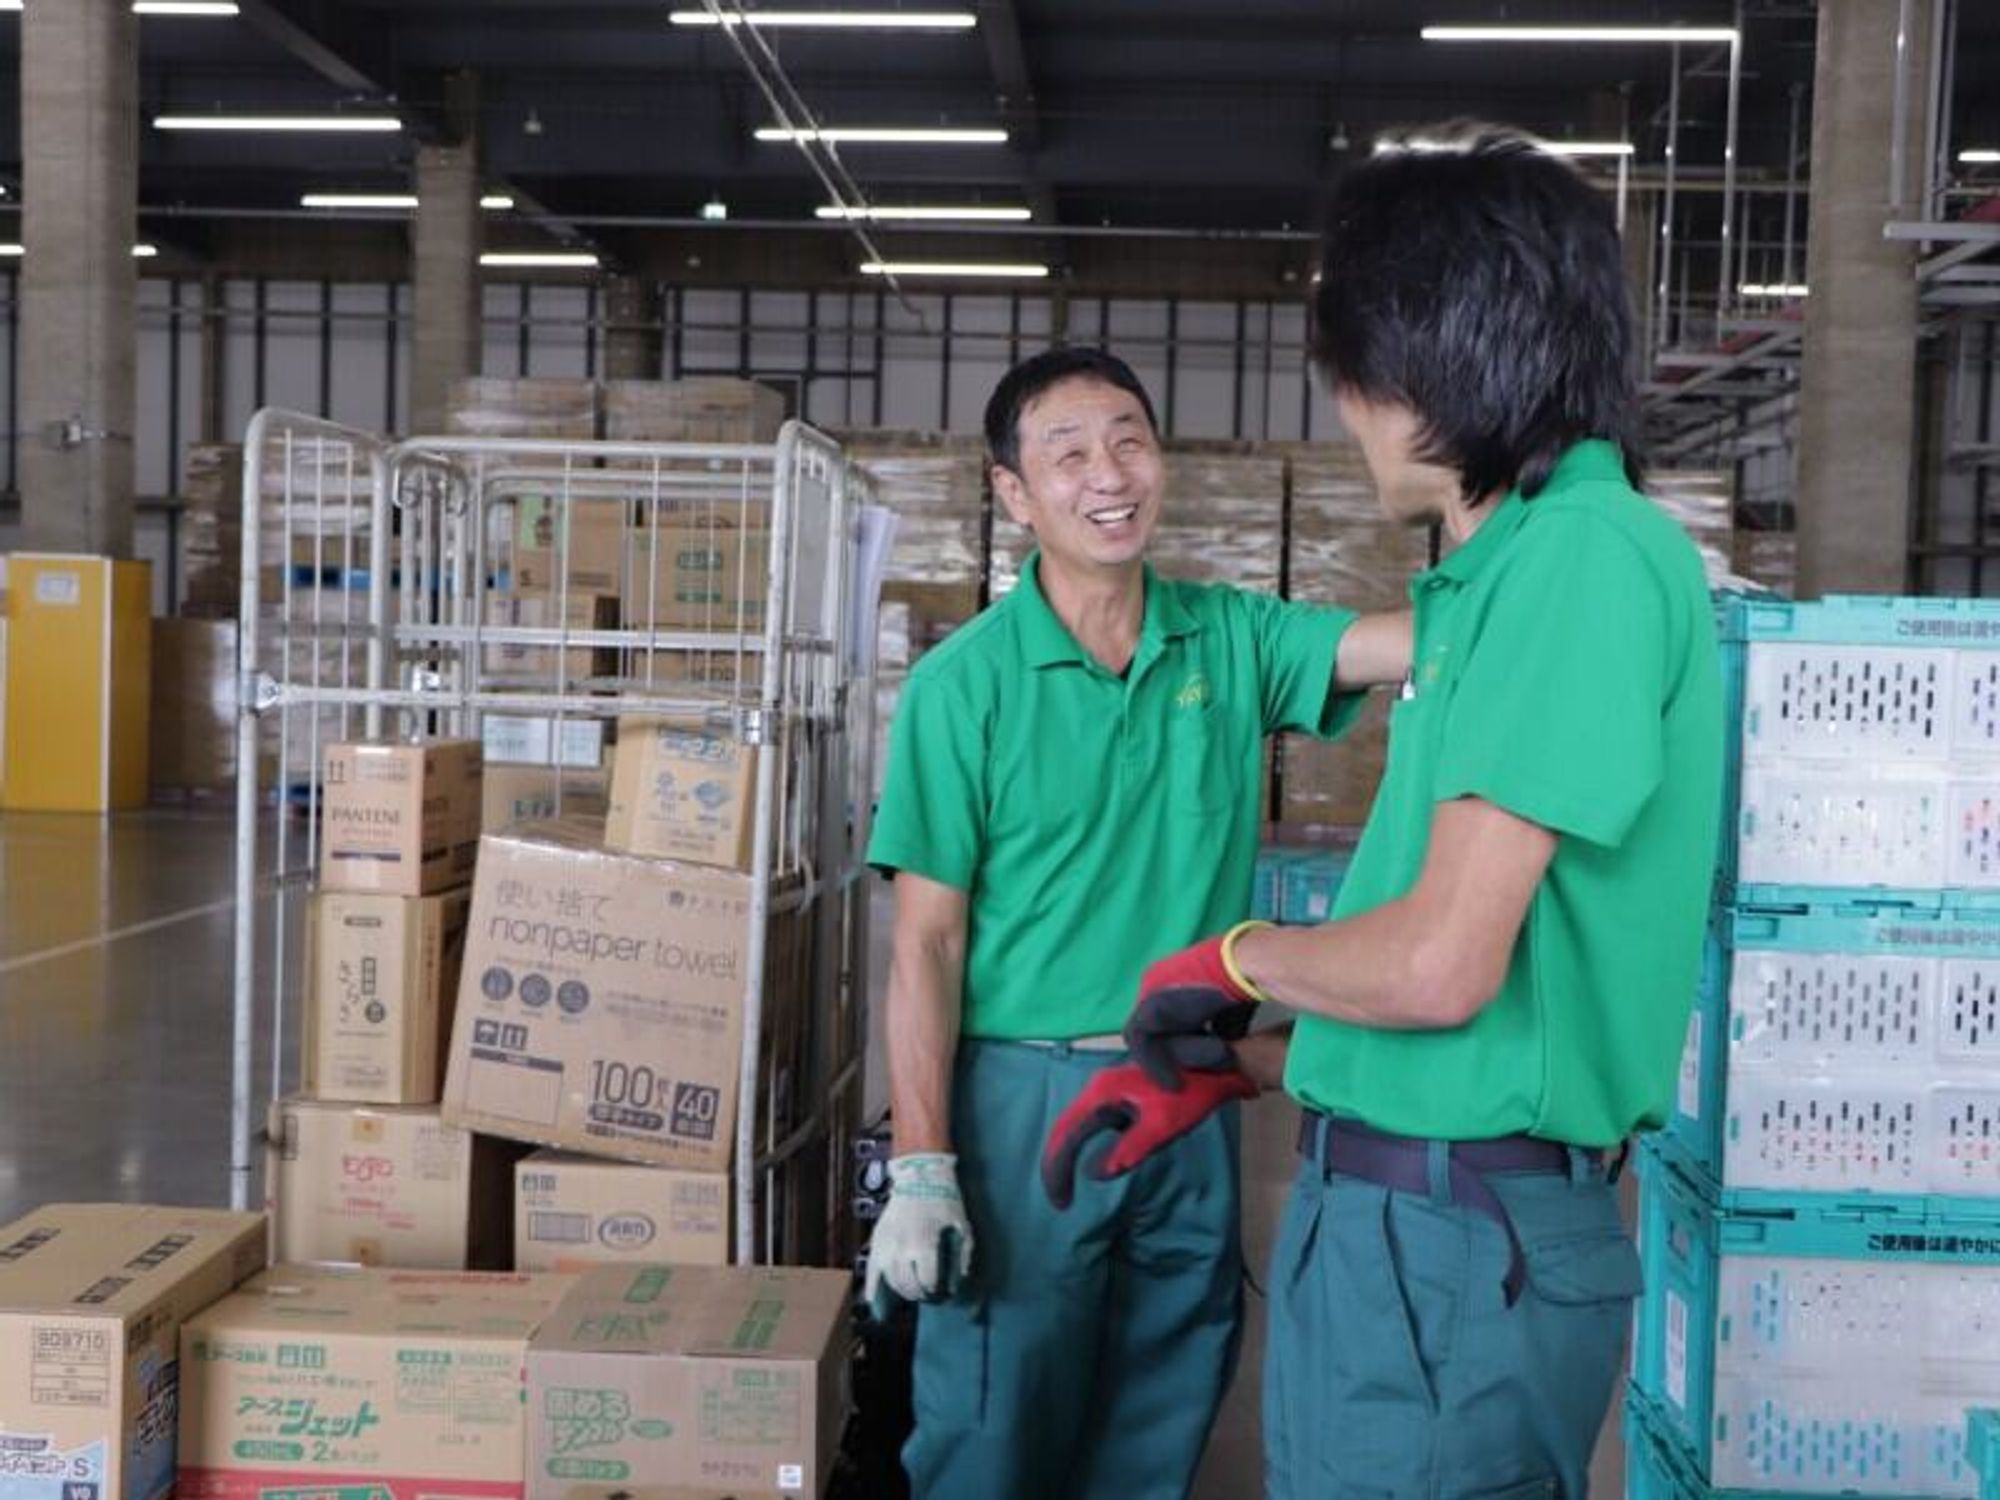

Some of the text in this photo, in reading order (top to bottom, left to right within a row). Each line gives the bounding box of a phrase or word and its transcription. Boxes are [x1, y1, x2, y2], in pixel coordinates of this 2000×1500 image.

[489, 915, 737, 980] nonpaper towel
[677, 1087, 716, 1121] 40
[73, 1456, 91, 1477] S
